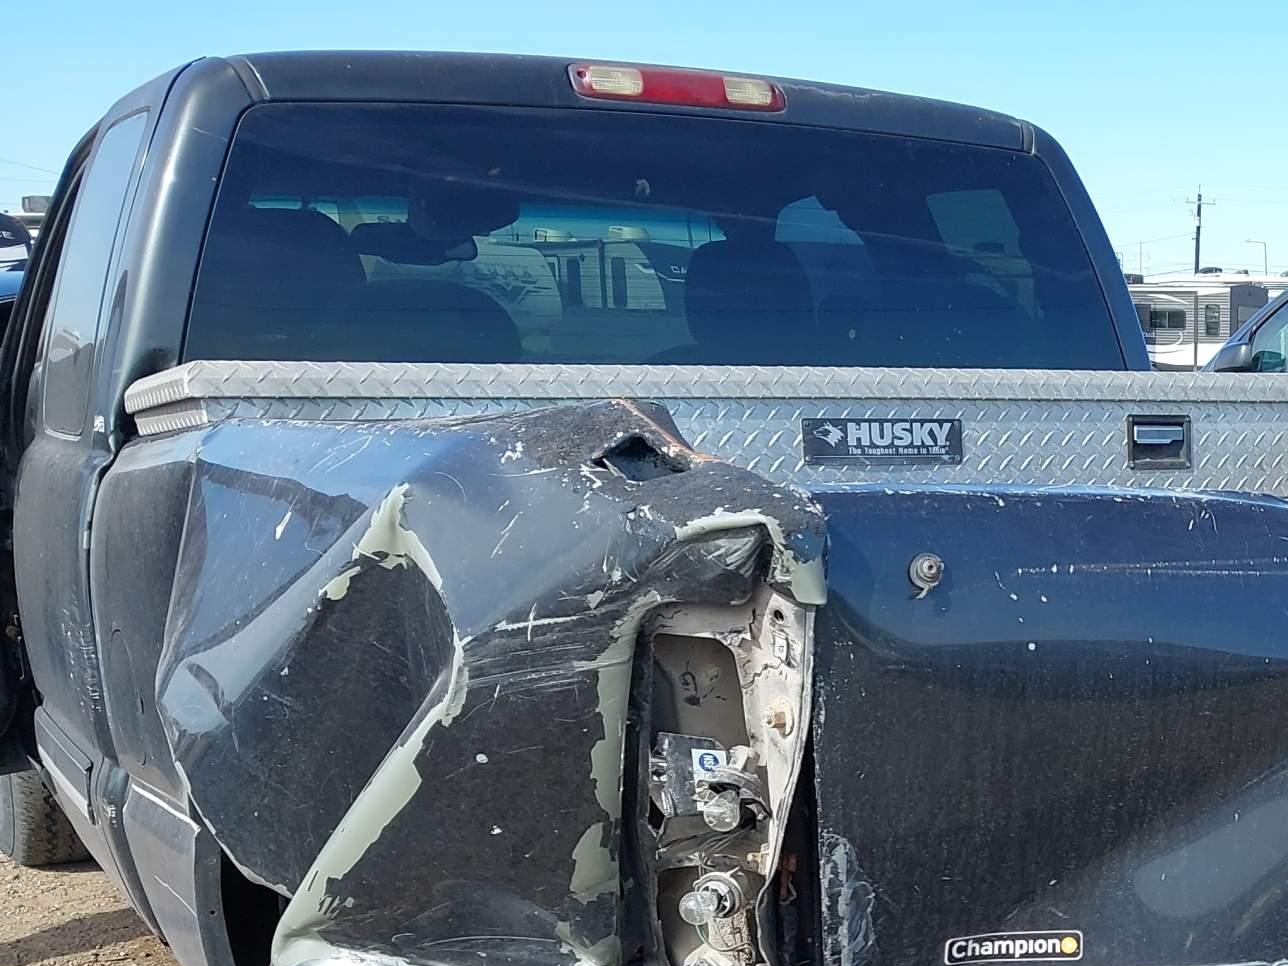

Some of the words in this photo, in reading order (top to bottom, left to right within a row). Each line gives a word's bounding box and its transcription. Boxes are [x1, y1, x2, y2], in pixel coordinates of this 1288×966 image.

[847, 422, 952, 446] HUSKY
[848, 447, 862, 455] The
[864, 447, 896, 456] Toughest
[898, 447, 918, 455] Name
[950, 939, 1062, 960] Champion
